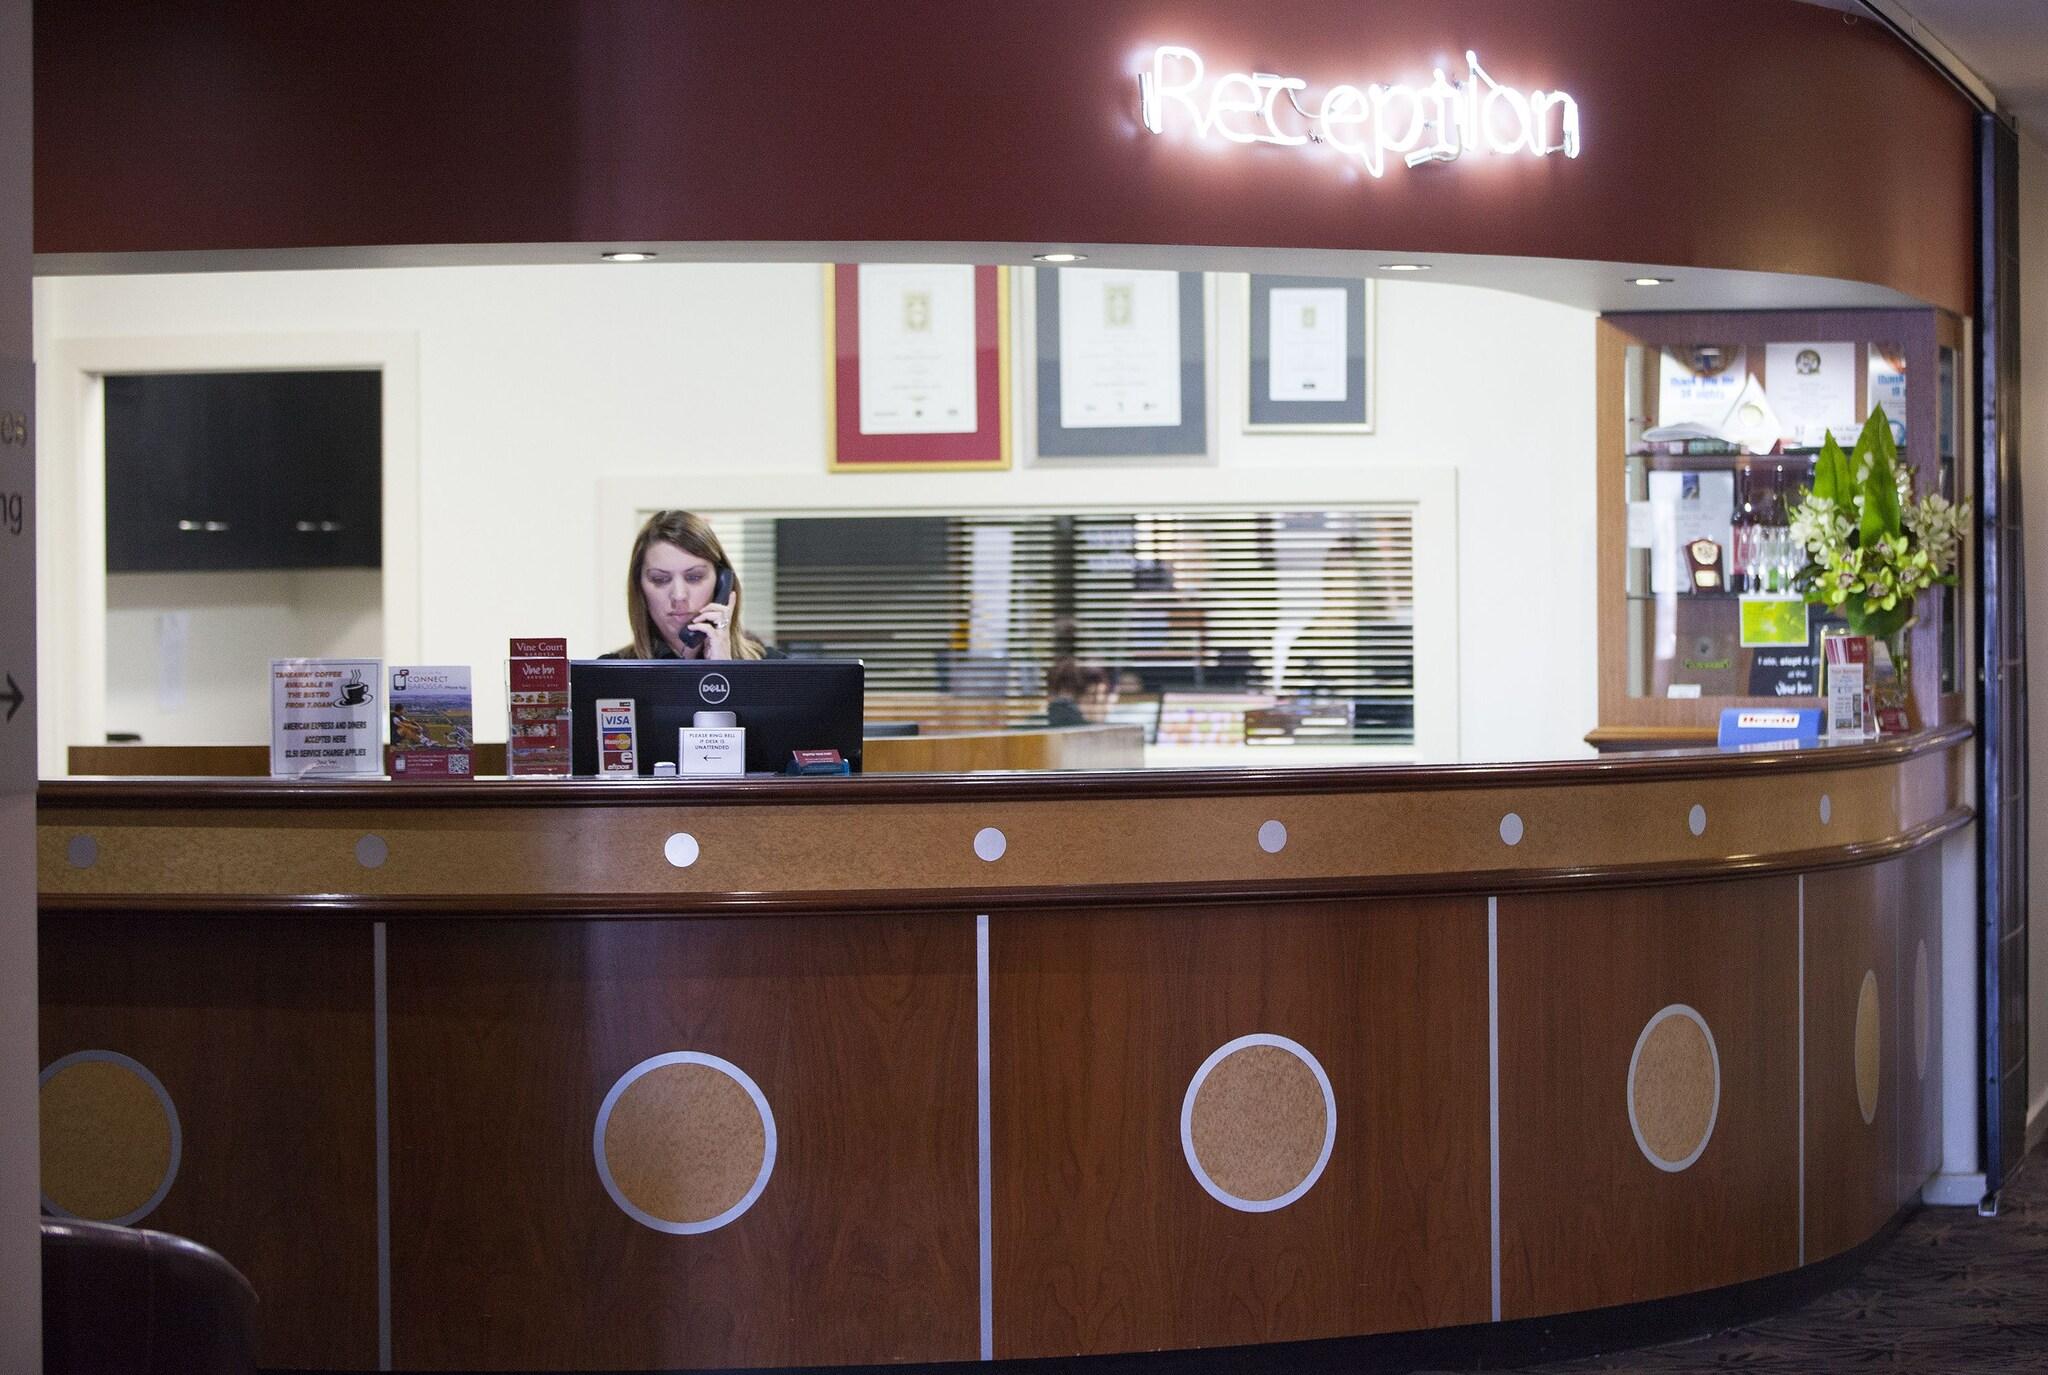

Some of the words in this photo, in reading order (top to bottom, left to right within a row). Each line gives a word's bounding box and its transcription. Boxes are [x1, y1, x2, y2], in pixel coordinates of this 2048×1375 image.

[1140, 45, 1581, 179] Reception
[516, 642, 537, 651] Vine
[538, 641, 563, 652] Court
[522, 662, 541, 676] Vine
[541, 663, 556, 675] Inn
[275, 671, 314, 679] TAKEAWAY
[407, 675, 449, 683] CONNECT
[285, 681, 323, 689] AVAILABLE
[702, 683, 727, 693] DELL
[287, 691, 302, 699] THE
[605, 715, 630, 725] VISA
[283, 722, 310, 731] AMERICAN
[310, 721, 335, 730] EXPRESS
[335, 721, 347, 730] AND
[347, 720, 368, 730] DINERS
[304, 735, 331, 744] ACCEPTED
[332, 735, 347, 743] HERE
[299, 748, 322, 758] SERVICE
[322, 748, 345, 758] CHARGE
[345, 747, 367, 757] APPLIES
